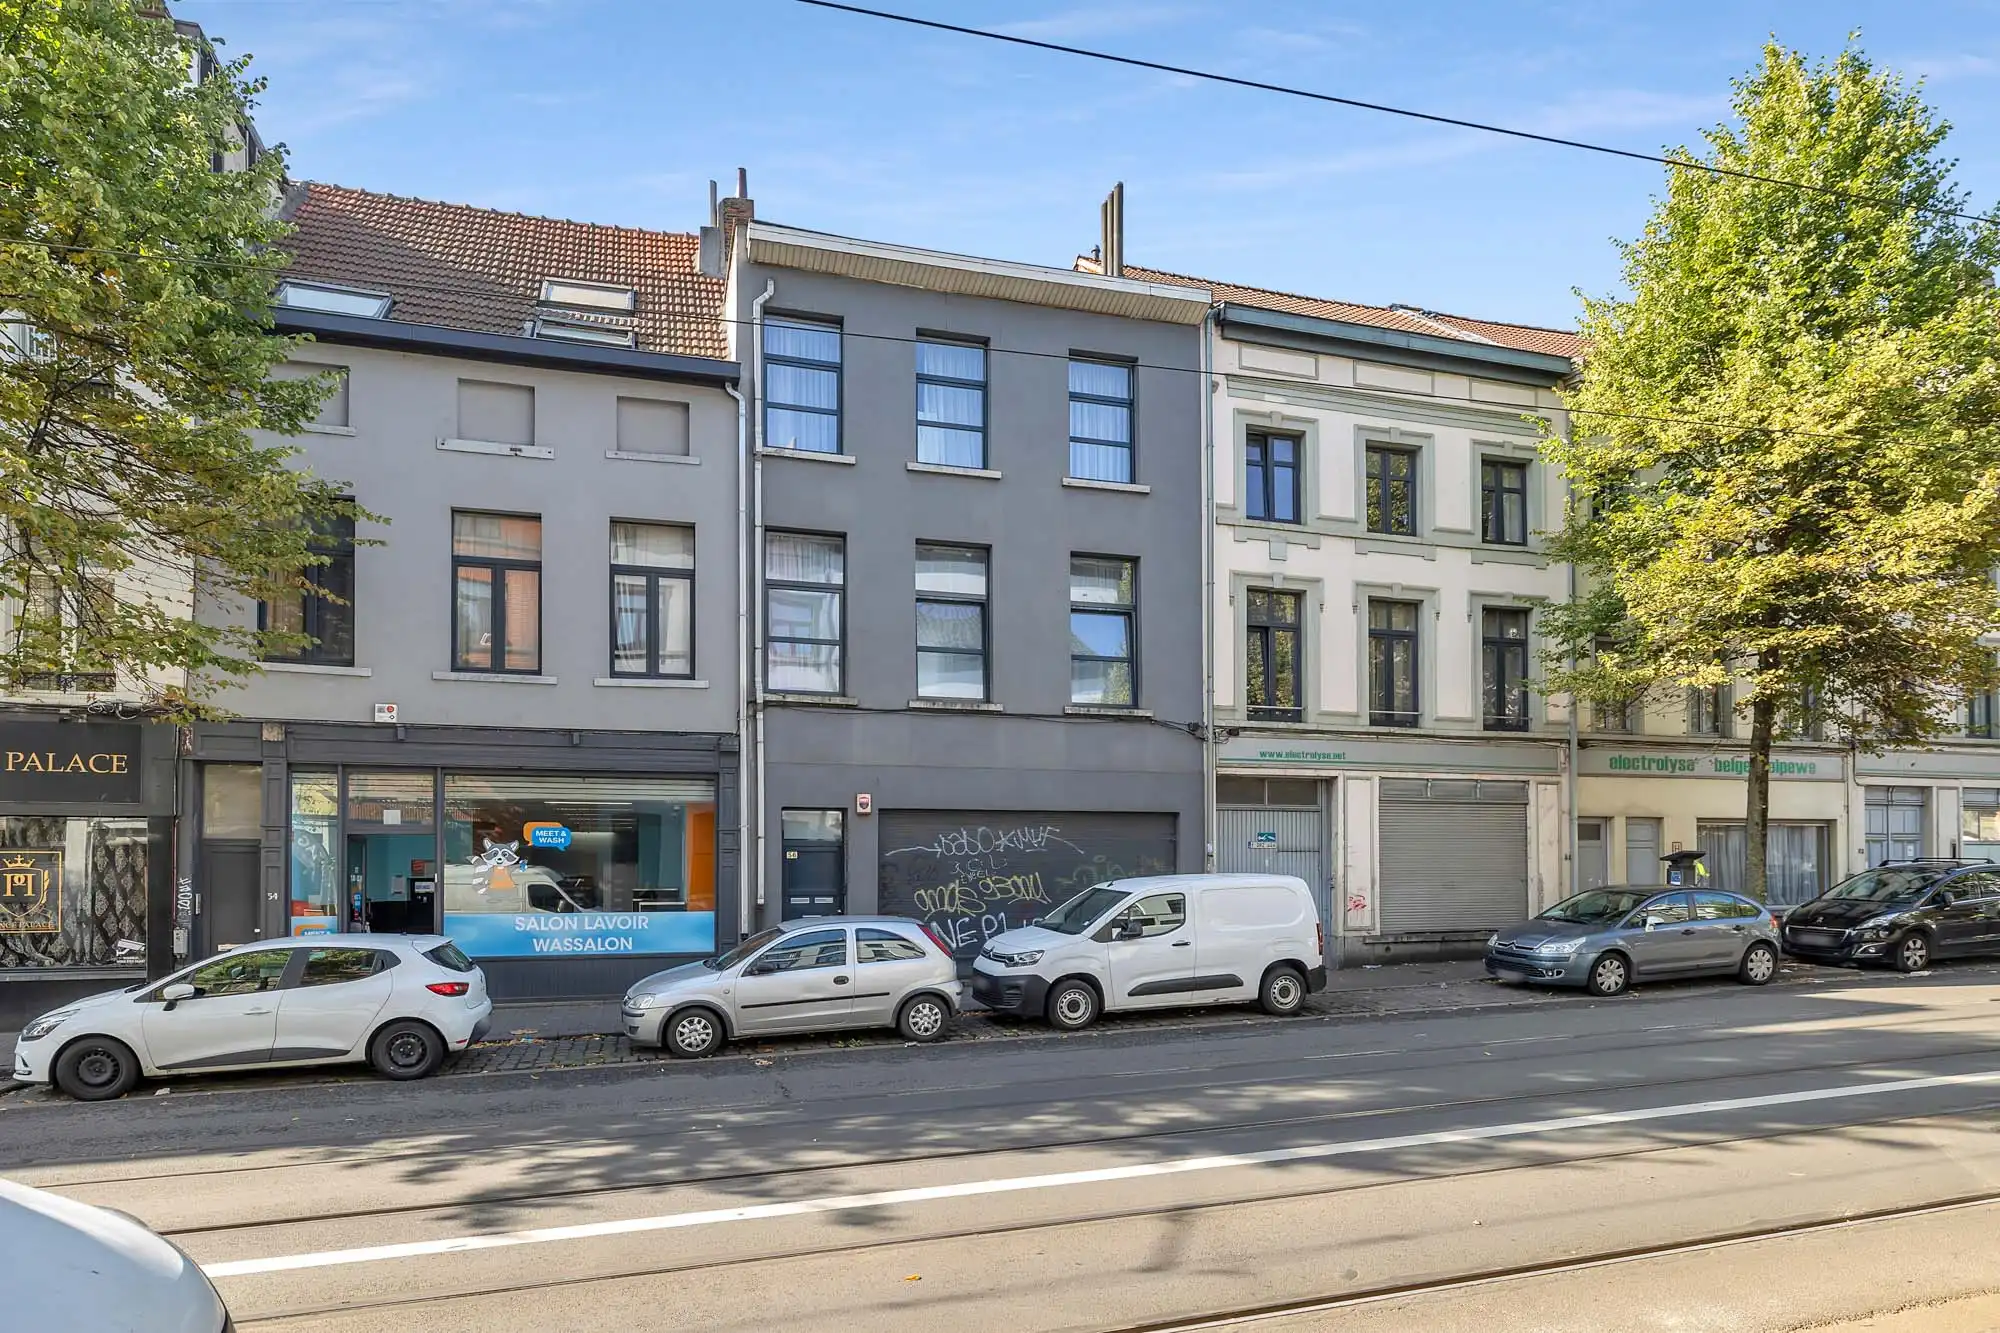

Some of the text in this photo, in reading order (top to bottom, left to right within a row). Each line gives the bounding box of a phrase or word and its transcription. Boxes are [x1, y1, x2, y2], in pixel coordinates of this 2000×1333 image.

[5, 751, 128, 774] PALACE
[515, 915, 649, 931] SALON LAVOIR
[532, 937, 633, 952] WASSALON
